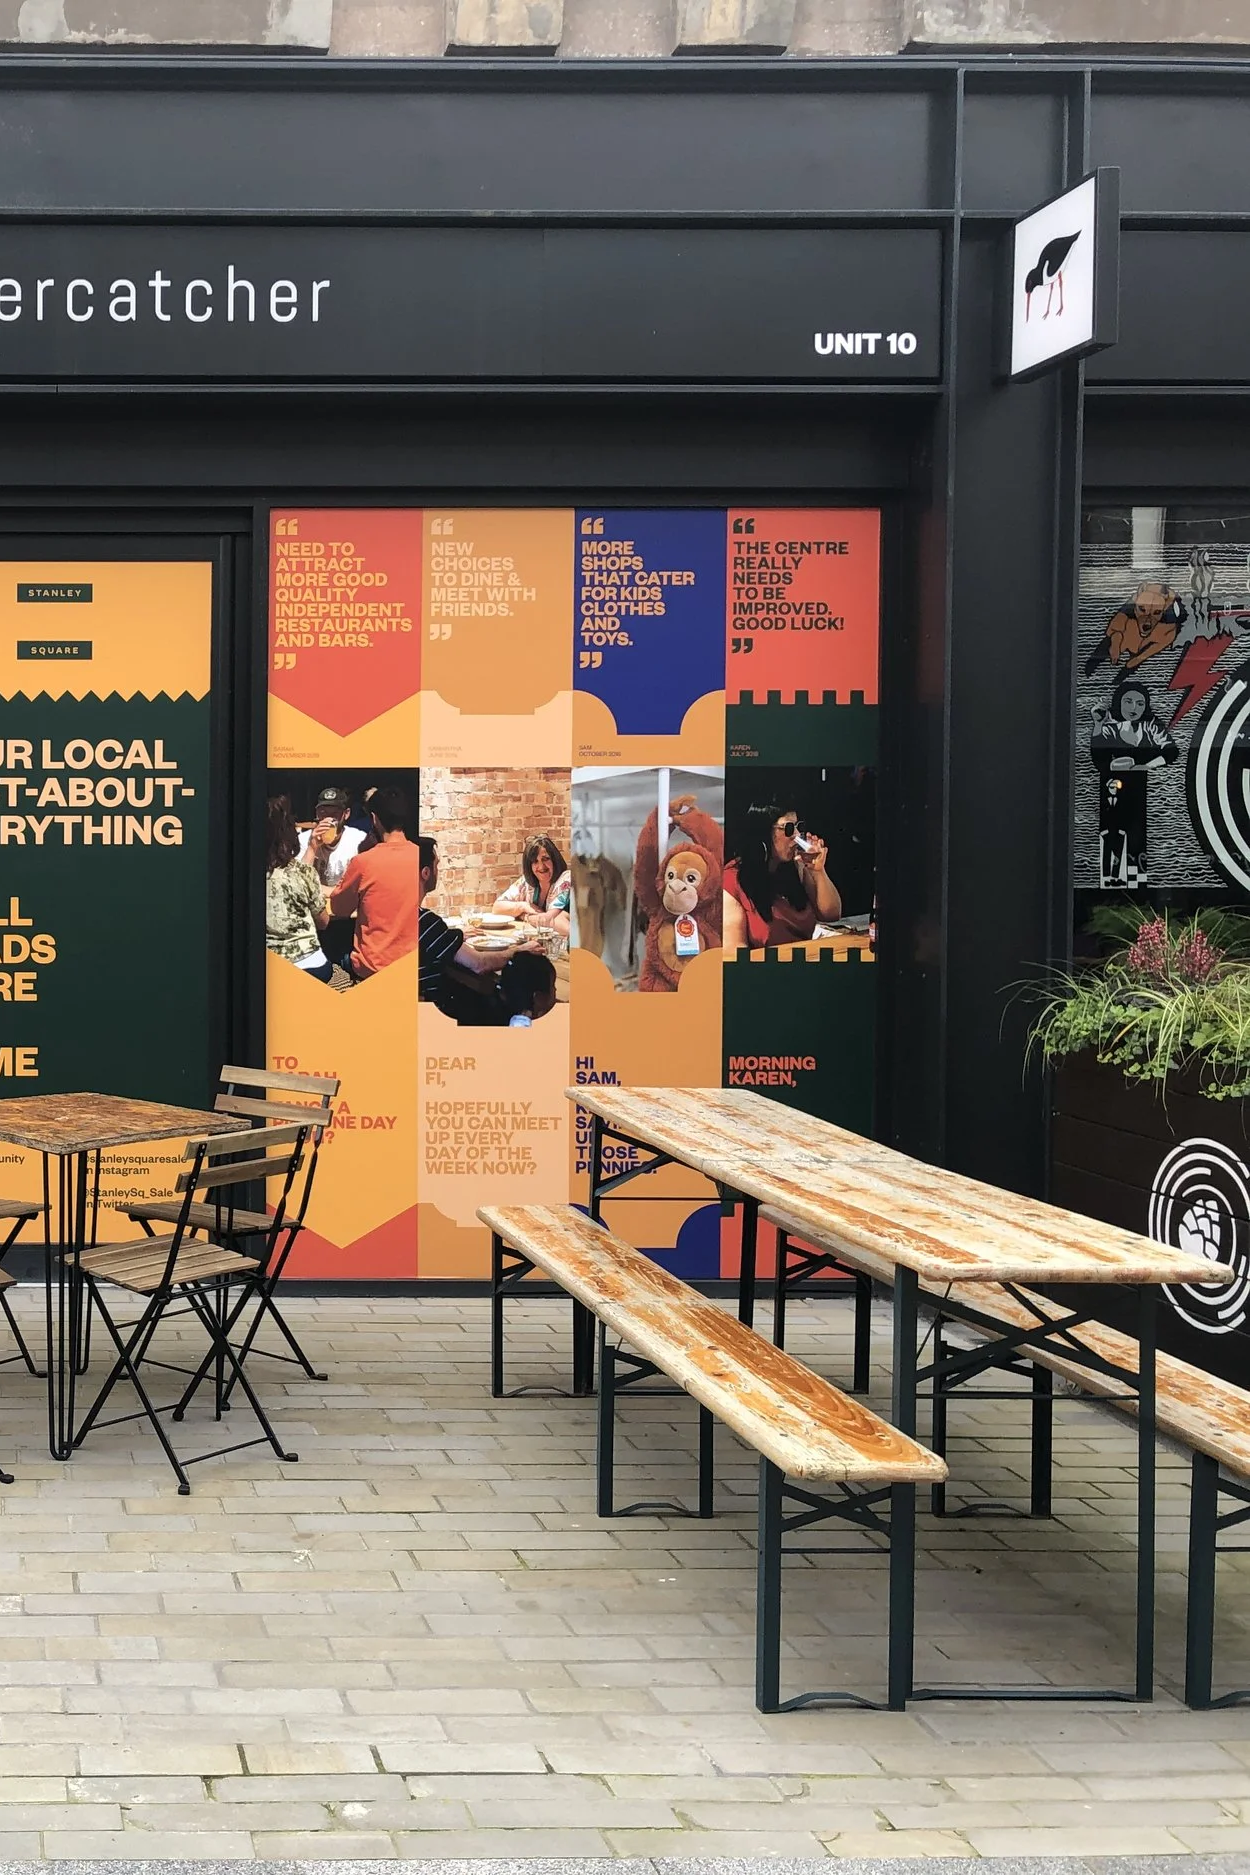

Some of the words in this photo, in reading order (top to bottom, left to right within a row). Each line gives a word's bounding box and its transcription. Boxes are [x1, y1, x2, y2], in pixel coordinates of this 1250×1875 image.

[814, 333, 882, 354] UNIT
[886, 333, 917, 354] 10
[276, 542, 325, 556] NEED
[329, 542, 354, 556] TO
[432, 542, 474, 555] NEW
[582, 541, 634, 555] MORE
[734, 542, 770, 554] THE
[774, 542, 848, 555] CENTRE
[276, 558, 365, 571] ATTRACT
[431, 557, 513, 571] CHOICES
[581, 556, 643, 570] SHOPS
[734, 557, 802, 570] REALLY
[276, 573, 329, 586] MORE
[332, 573, 387, 586] GOOD
[431, 573, 457, 586] TO
[461, 573, 503, 586] DINE
[508, 573, 520, 586] &
[582, 571, 631, 585] THAT
[635, 571, 695, 585] CATER
[733, 572, 793, 585] NEEDS
[275, 588, 357, 602] QUALITY
[431, 588, 482, 601] MEET
[486, 588, 536, 601] WITH
[581, 587, 617, 600] FOR
[620, 587, 662, 600] KIDS
[733, 587, 758, 600] TO
[763, 587, 786, 600] BE
[276, 603, 405, 616] INDEPENDENT
[431, 603, 514, 616] FRIENDS.
[581, 602, 666, 615] CLOTHES
[733, 602, 832, 615] IMPROVED.
[275, 618, 412, 632] RESTAURANTS
[581, 617, 620, 630] AND
[732, 617, 786, 630] GOOD
[790, 617, 844, 630] LUCK!
[275, 634, 314, 647] AND
[318, 634, 373, 647] BARS.
[581, 632, 633, 646] TOYS.
[31, 646, 79, 655] SQUARE
[42, 739, 177, 770] LOCAL
[273, 1056, 298, 1069] TO
[425, 1057, 476, 1070] DEAR
[576, 1057, 594, 1069] HI
[729, 1056, 816, 1070] MORNING
[425, 1072, 446, 1087] FI,
[575, 1072, 621, 1086] SAM,
[729, 1072, 797, 1087] KAREN,
[425, 1102, 532, 1115] HOPEFULLY
[361, 1116, 397, 1129] DAY
[425, 1117, 465, 1130] YOU
[467, 1117, 507, 1130] CAN
[511, 1117, 562, 1130] MEET
[425, 1132, 451, 1144] UP
[454, 1132, 514, 1145] EVERY
[425, 1147, 463, 1160] DAY
[466, 1147, 490, 1160] OF
[494, 1147, 532, 1160] THE
[425, 1161, 478, 1174] WEEK
[482, 1161, 537, 1174] NOW?
